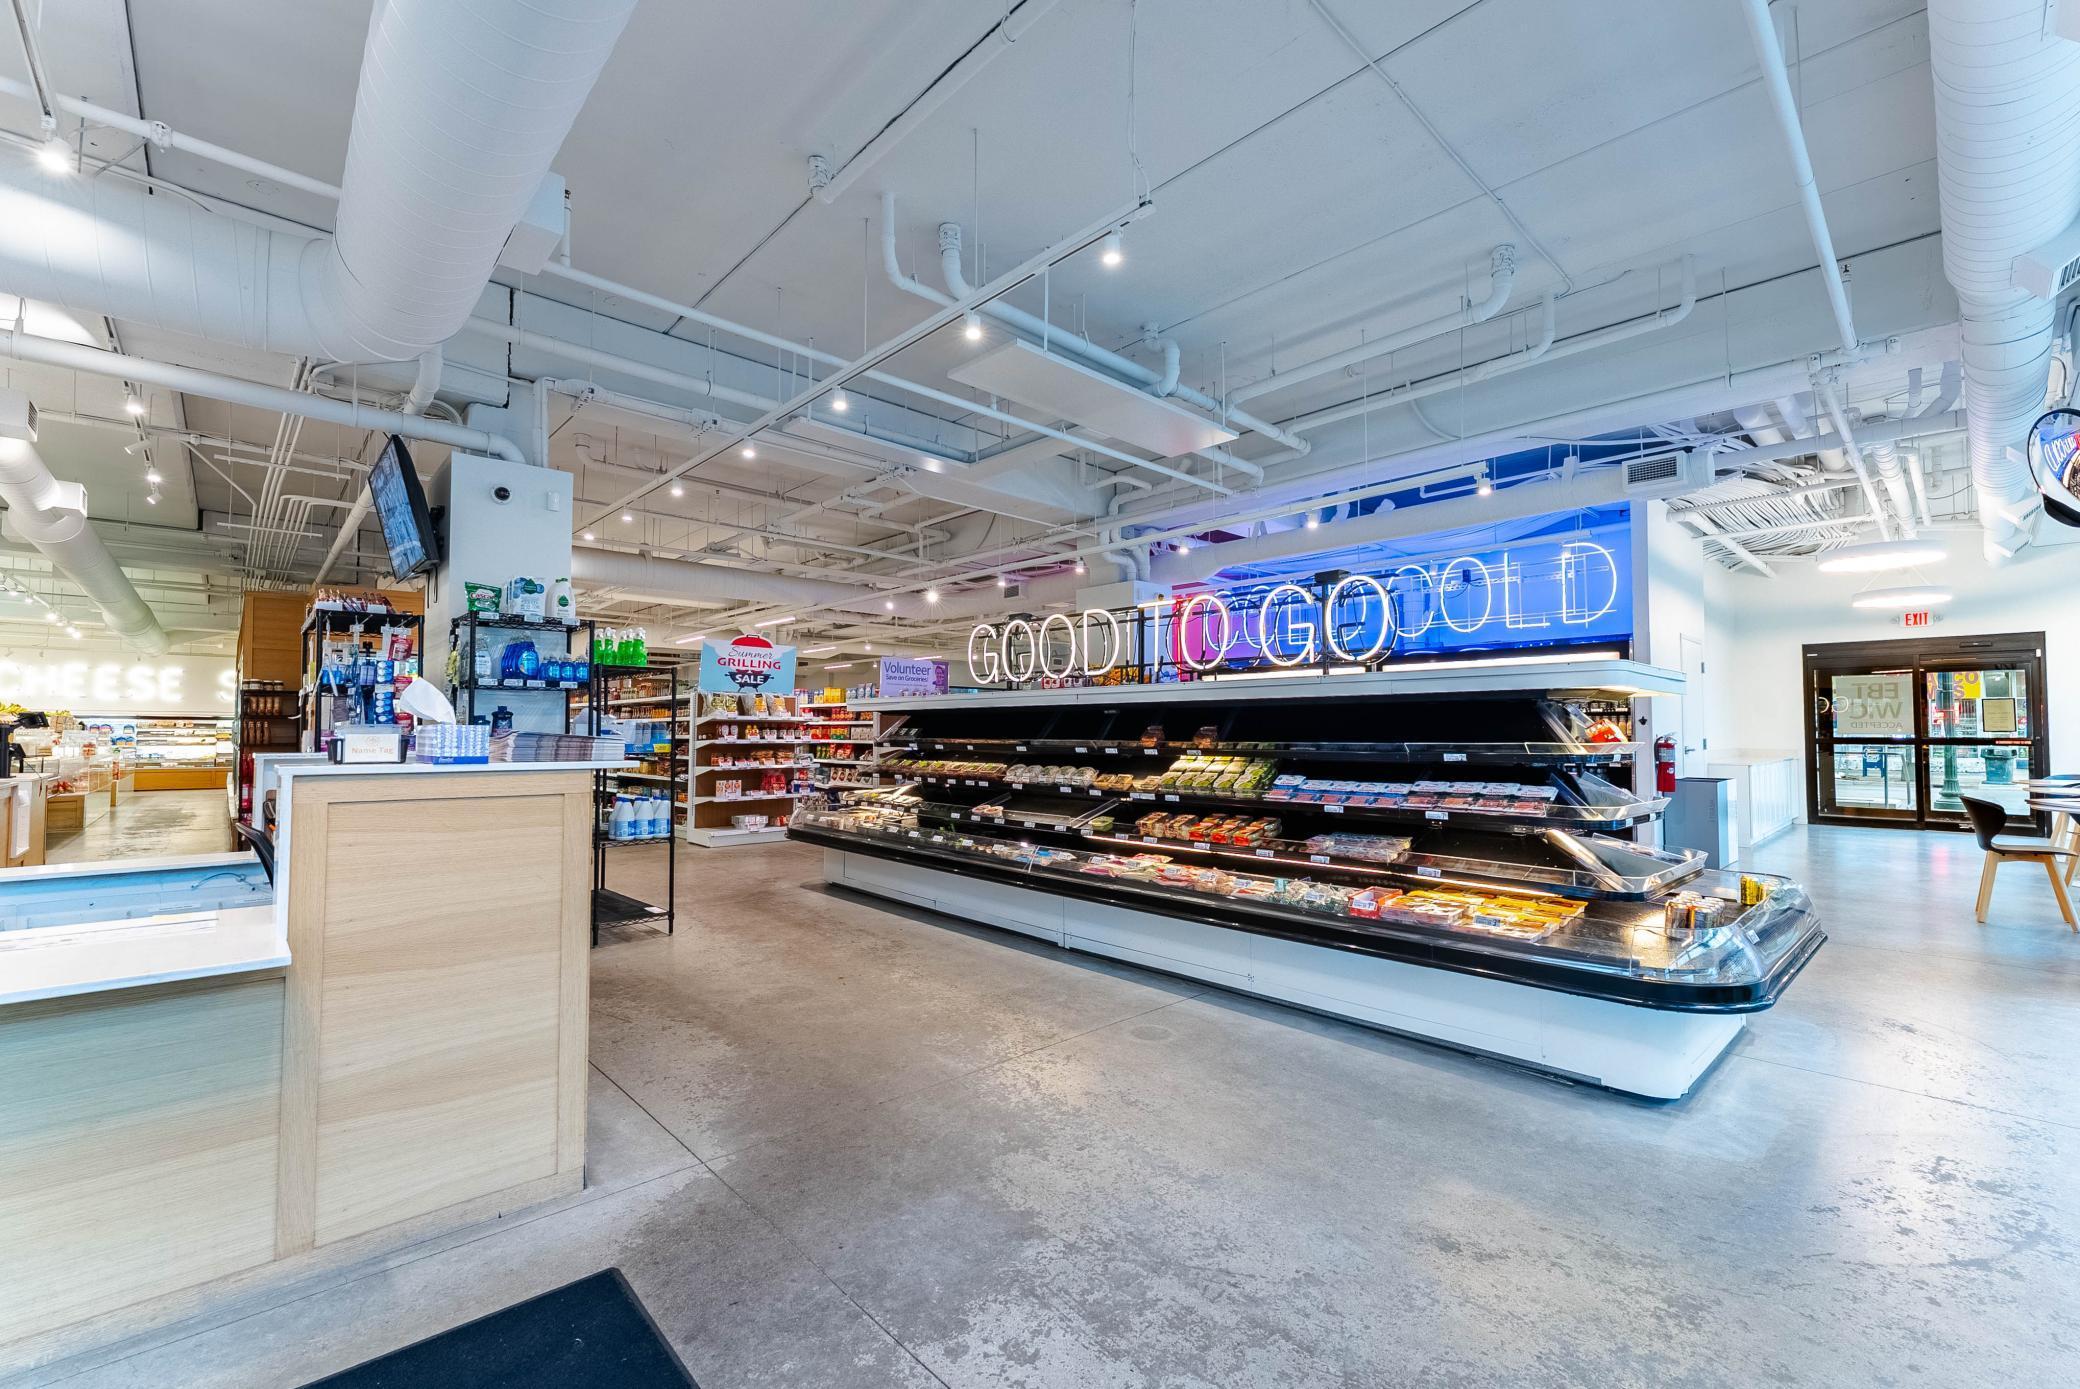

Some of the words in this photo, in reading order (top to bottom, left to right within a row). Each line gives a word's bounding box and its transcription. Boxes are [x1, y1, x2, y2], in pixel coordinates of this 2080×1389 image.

[1387, 542, 1617, 637] COLD
[1905, 612, 1928, 626] EXIT
[968, 609, 1120, 684] GOOD
[1137, 595, 1229, 672] TO
[1259, 575, 1388, 667] GO
[728, 646, 774, 659] Summer
[717, 657, 781, 670] GRILLING
[884, 661, 931, 676] Volunteer
[0, 660, 184, 702] CHEESE
[735, 674, 765, 684] SALE
[378, 747, 394, 755] Tag
